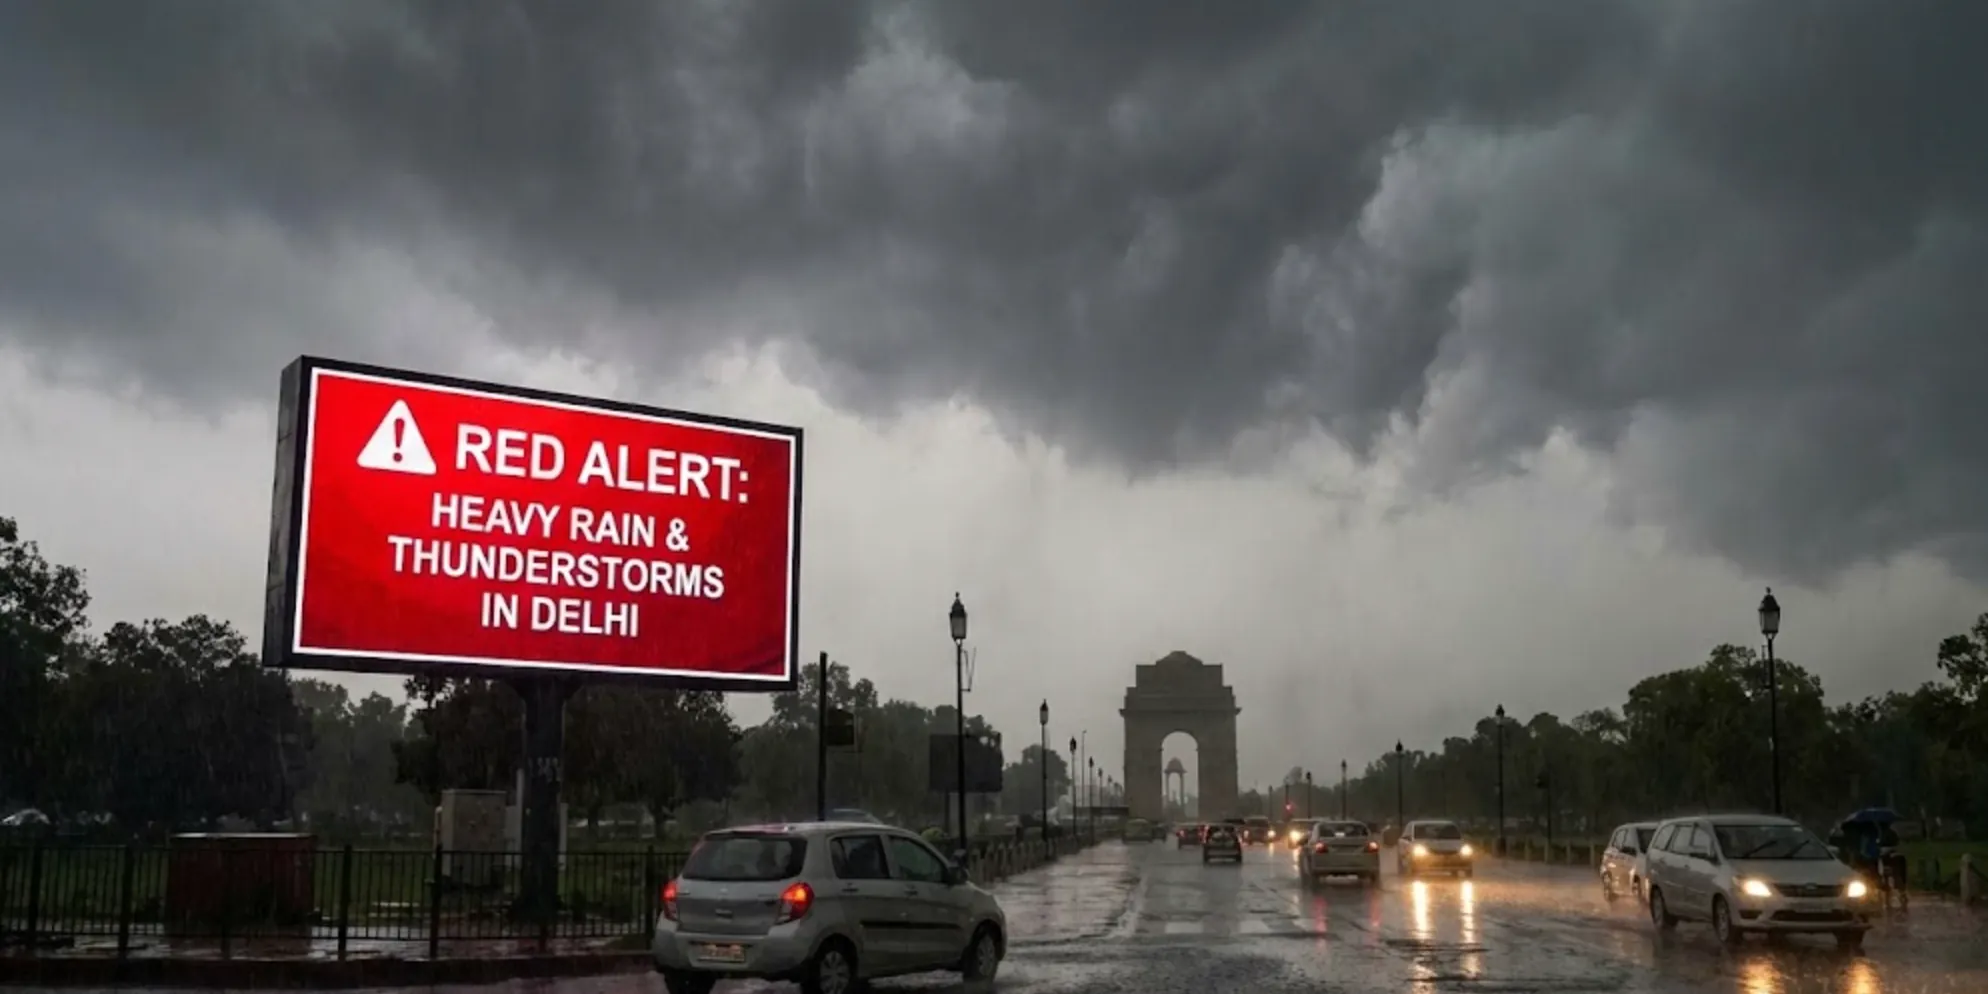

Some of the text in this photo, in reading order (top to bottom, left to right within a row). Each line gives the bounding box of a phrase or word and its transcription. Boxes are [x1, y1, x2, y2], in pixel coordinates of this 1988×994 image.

[455, 423, 749, 503] RED ALERT:
[432, 492, 690, 552] HEAVY RAIN &
[387, 535, 725, 599] THUNDERSTORMS
[481, 592, 639, 637] IN DELHI
